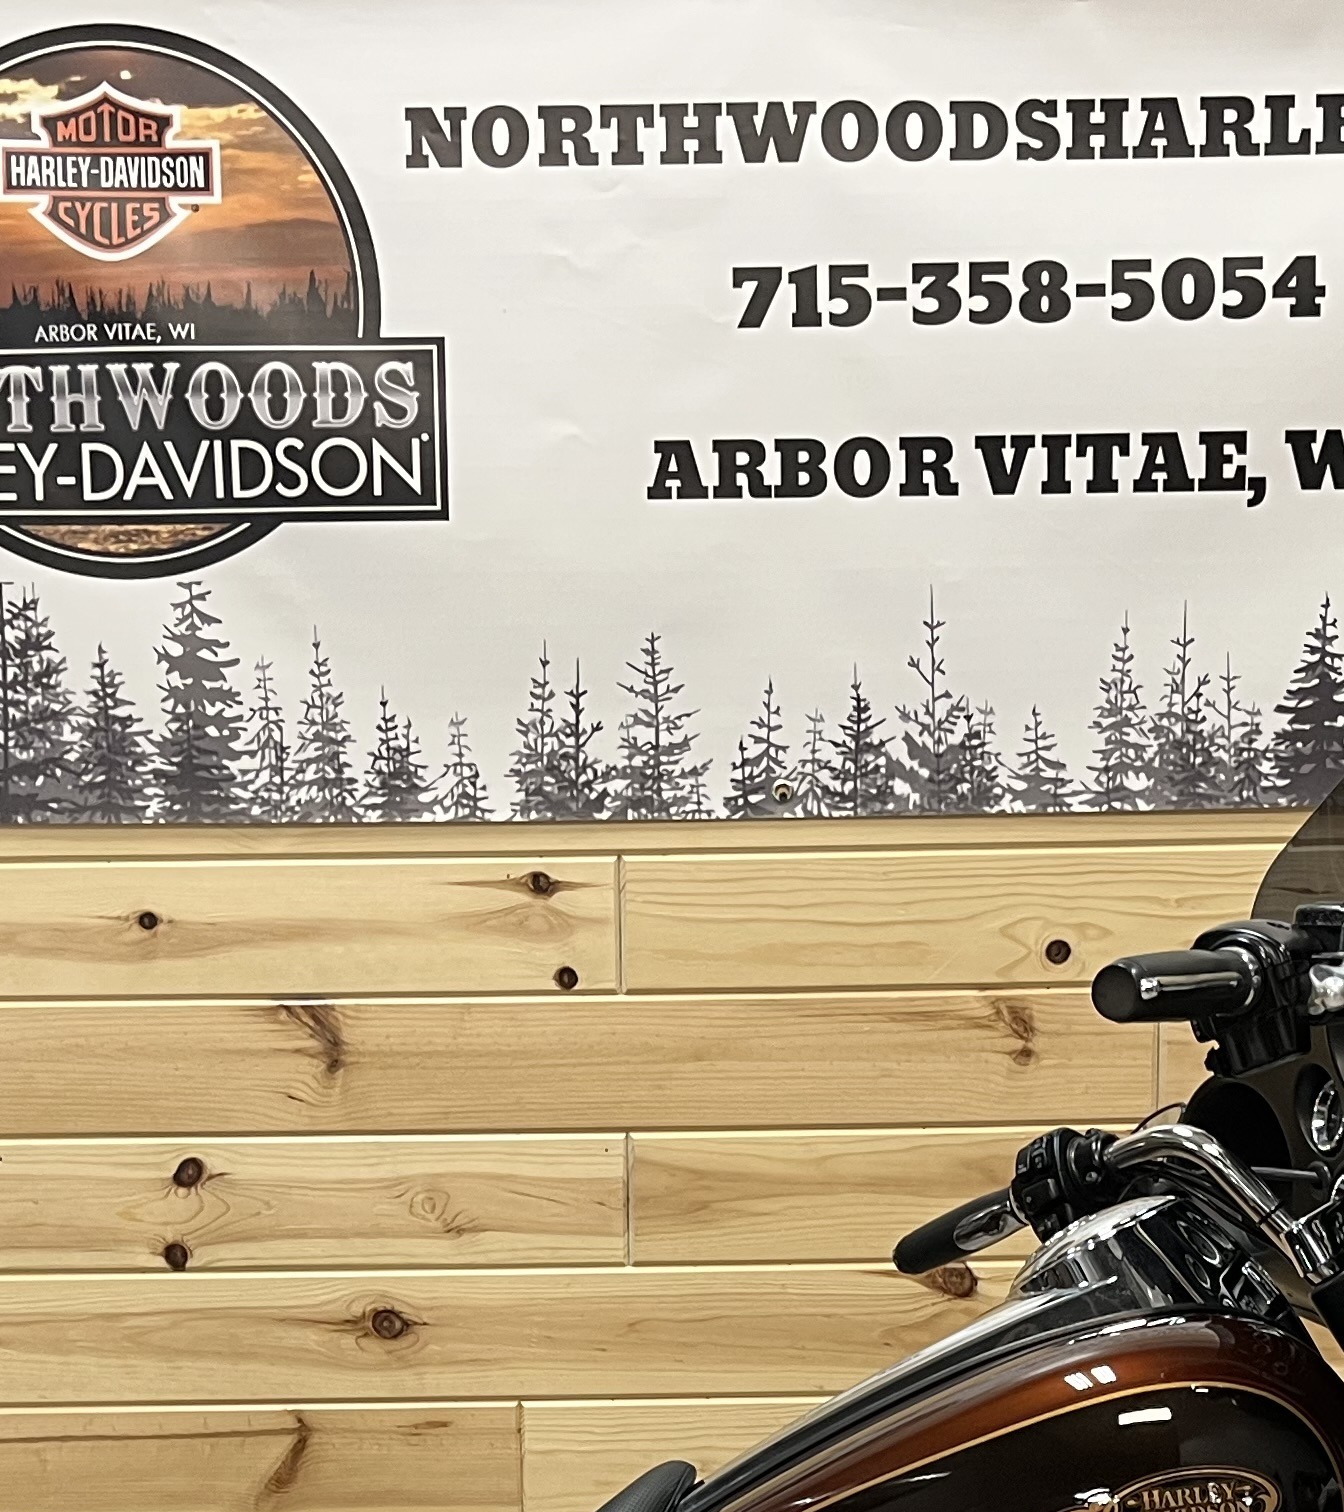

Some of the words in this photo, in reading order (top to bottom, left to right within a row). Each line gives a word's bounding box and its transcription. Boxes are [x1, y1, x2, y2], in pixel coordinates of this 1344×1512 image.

[57, 103, 159, 142] MOTOR
[10, 154, 205, 188] HARLEY-DAVIDSON
[58, 201, 160, 246] CYCLES
[733, 256, 1325, 328] 715-358-5054
[34, 325, 98, 342] ARBOR
[104, 323, 162, 344] VITAE,
[167, 323, 196, 340] WI
[647, 437, 959, 499] ARBOR
[975, 431, 1266, 507] VITAE,
[1141, 1482, 1236, 1511] HARLEY
